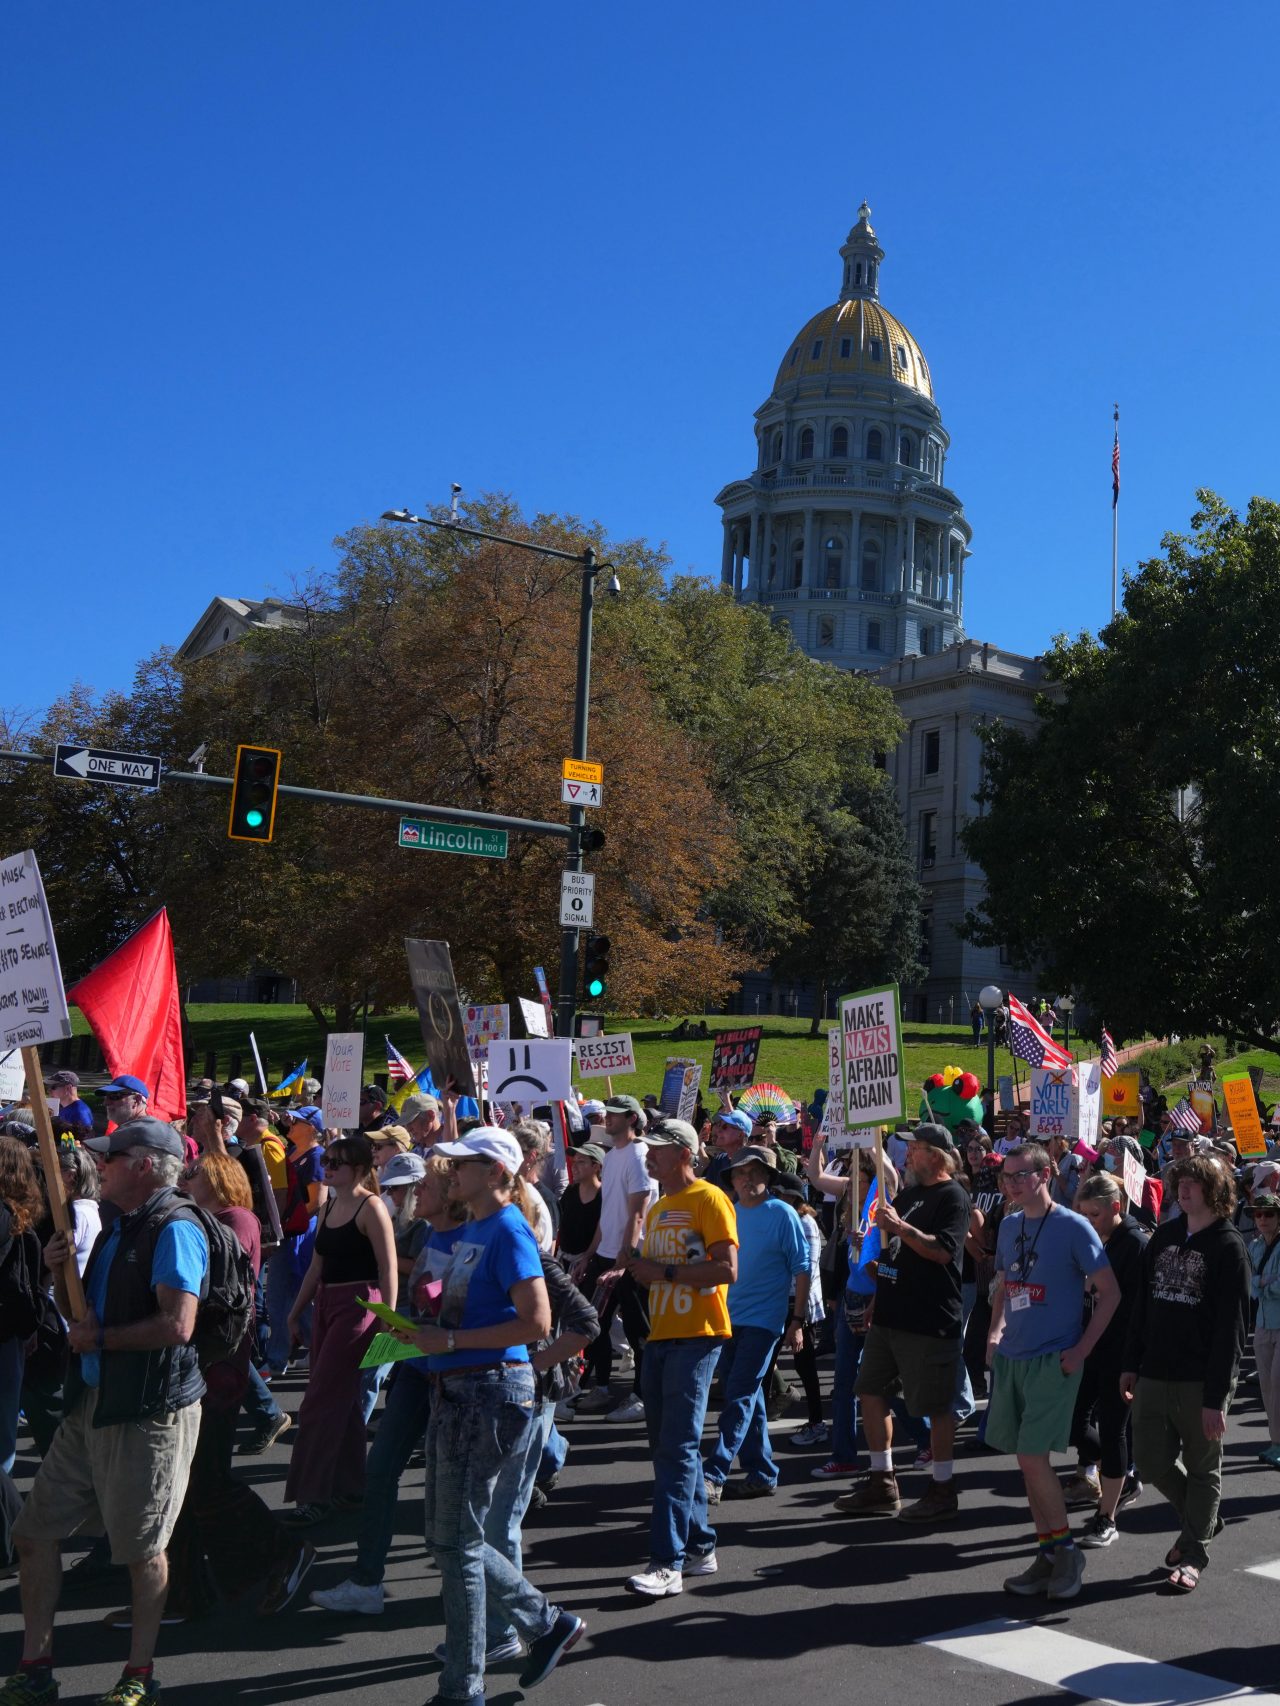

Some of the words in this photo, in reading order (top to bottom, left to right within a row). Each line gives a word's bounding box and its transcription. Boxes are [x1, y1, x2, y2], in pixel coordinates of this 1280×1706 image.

[89, 759, 116, 773] ONE
[122, 762, 149, 777] WAY
[568, 771, 598, 781] VEHICLES
[570, 763, 596, 773] TURNING
[421, 826, 483, 851] Lincoln
[491, 834, 498, 843] St
[485, 843, 498, 852] 100
[500, 845, 504, 853] E
[1, 865, 27, 888] MUSK
[571, 875, 585, 884] BUS
[563, 886, 593, 896] PRIORITY
[10, 893, 41, 920] ELECTION
[564, 913, 589, 923] SIGNAL
[21, 941, 51, 961] SENATE
[844, 1002, 885, 1033] MAKE
[580, 1040, 626, 1058] RESIST
[845, 1026, 890, 1059] NAZIS
[580, 1055, 631, 1071] FASCISM
[847, 1052, 898, 1085] AFRAID
[1036, 1072, 1070, 1100] VOTE
[1188, 1081, 1211, 1091] TRAITOR
[849, 1080, 893, 1111] AGAIN
[1033, 1098, 1069, 1115] EARLY
[1040, 1116, 1065, 1126] FDT
